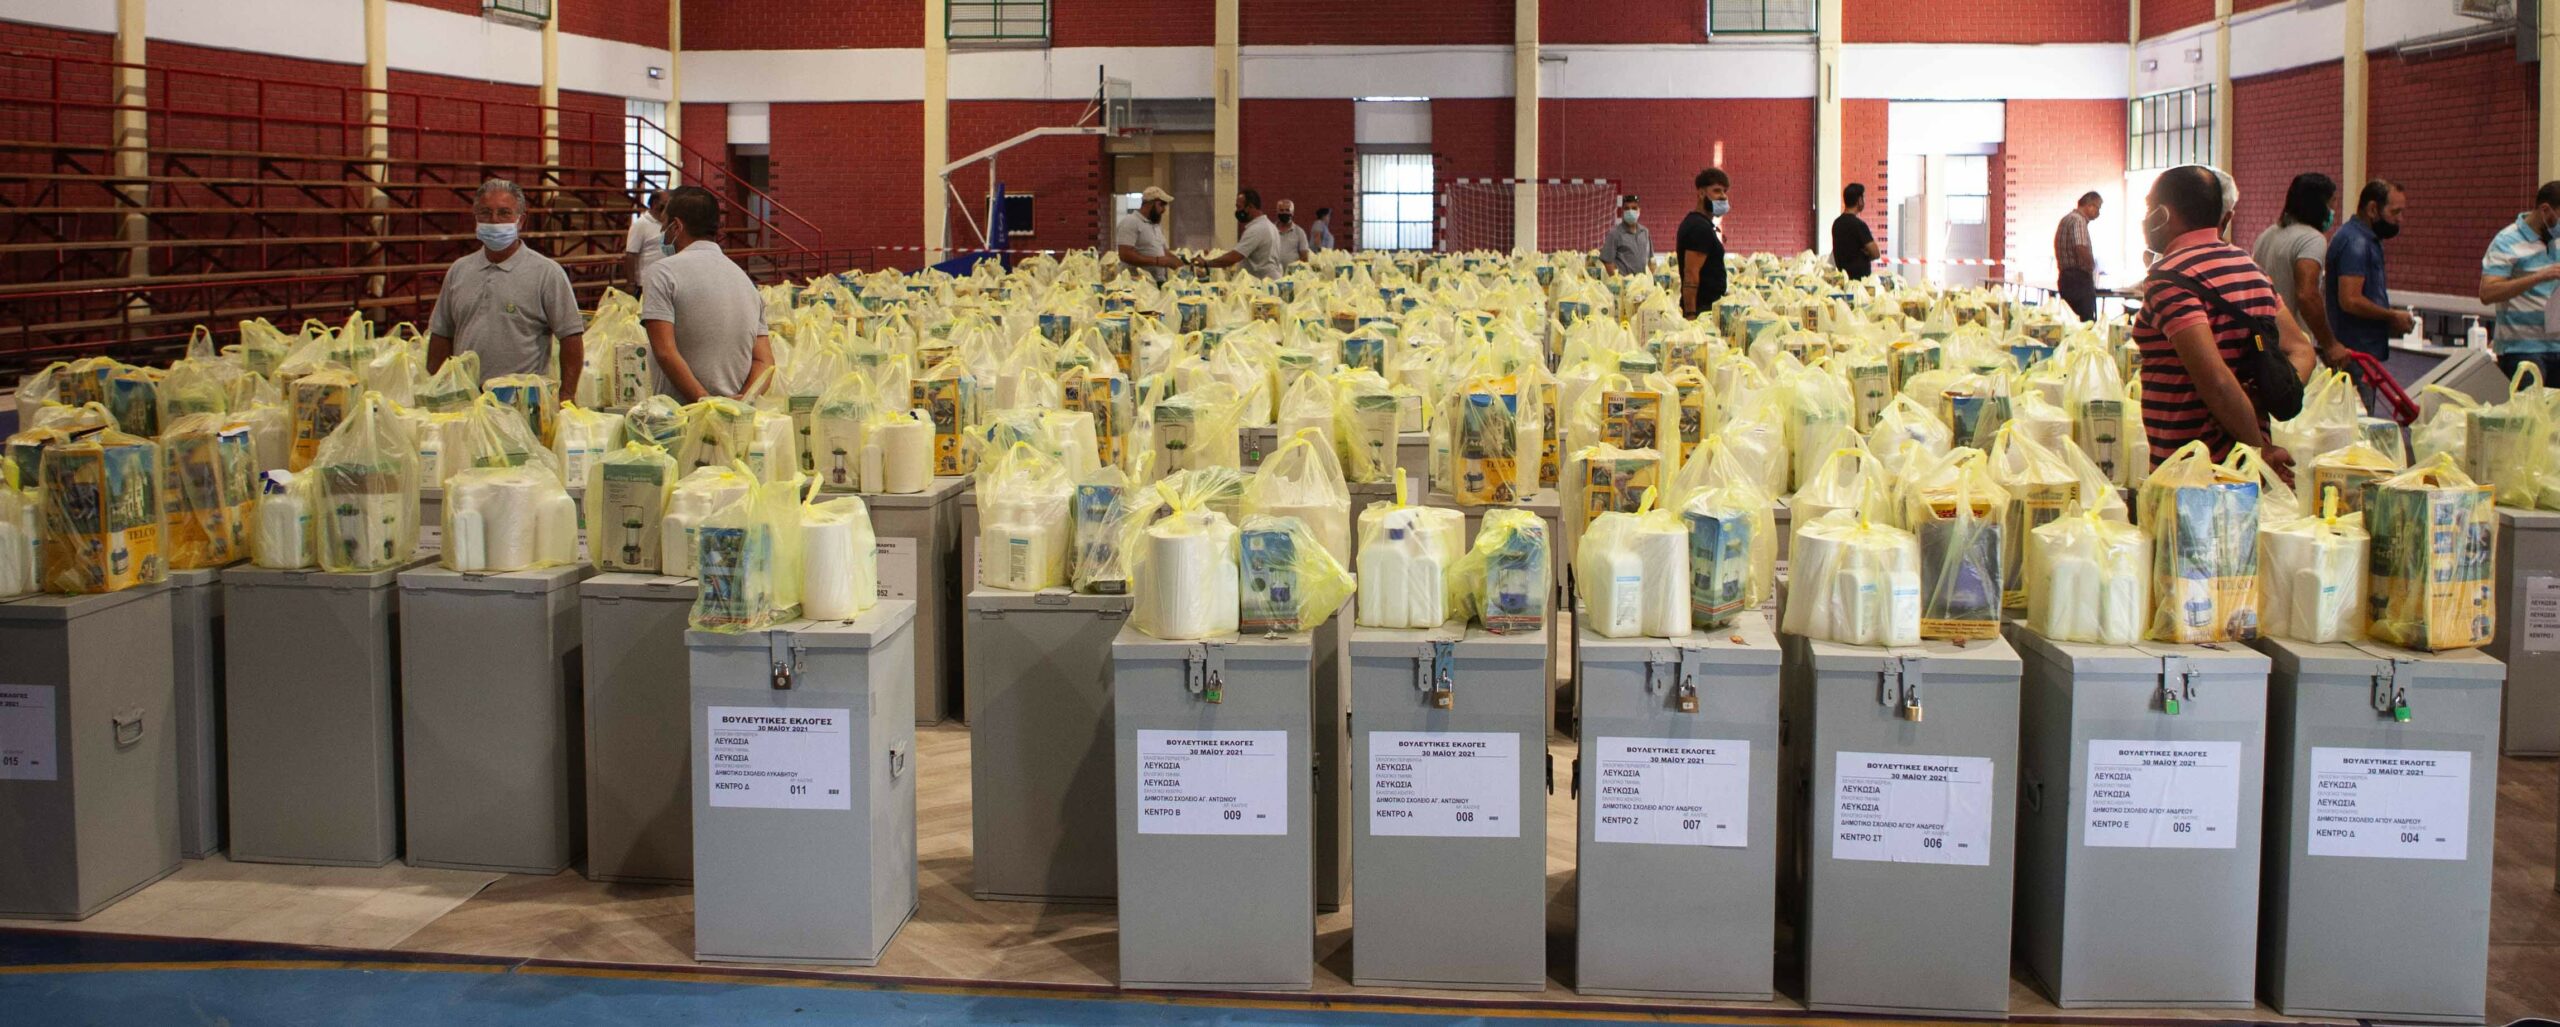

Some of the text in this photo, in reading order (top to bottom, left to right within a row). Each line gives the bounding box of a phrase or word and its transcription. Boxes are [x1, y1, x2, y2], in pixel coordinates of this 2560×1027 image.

[128, 527, 155, 540] TELCO
[3, 756, 18, 765] 015
[2095, 772, 2132, 780] ΛΕΥΚΩΣΙΑ
[1144, 779, 1180, 787] ΛΕΥΚΩΣΙΑ
[2318, 781, 2357, 789] ΛΕΥΚΩΣΙΑ
[791, 785, 807, 795] 011
[1602, 787, 1640, 795] ΛΕΥΚΩΣΙΑ
[1842, 785, 1880, 793] ΛΕΥΚΩΣΙΑ
[2093, 790, 2130, 798] ΛΕΥΚΩΣΙΑ
[1841, 803, 1879, 811] ΛΕΥΚΩΣΙΑ
[2317, 799, 2356, 807] ΛΕΥΚΩΣΙΑ
[1224, 810, 1241, 820] 009
[1408, 810, 1413, 818] Α
[1456, 812, 1474, 822] 008
[1602, 816, 1639, 825] ΚΕΝΤΡΟ Ζ
[2092, 820, 2122, 828] ΚΕΝΤΡΟ
[1683, 820, 1701, 830] 007
[2173, 822, 2191, 833] 005
[1840, 833, 1871, 841] ΚΕΝΤΡΟ
[2317, 829, 2348, 837] ΚΕΝΤΡΟ
[2401, 833, 2419, 843] 004
[1924, 838, 1942, 848] 006
